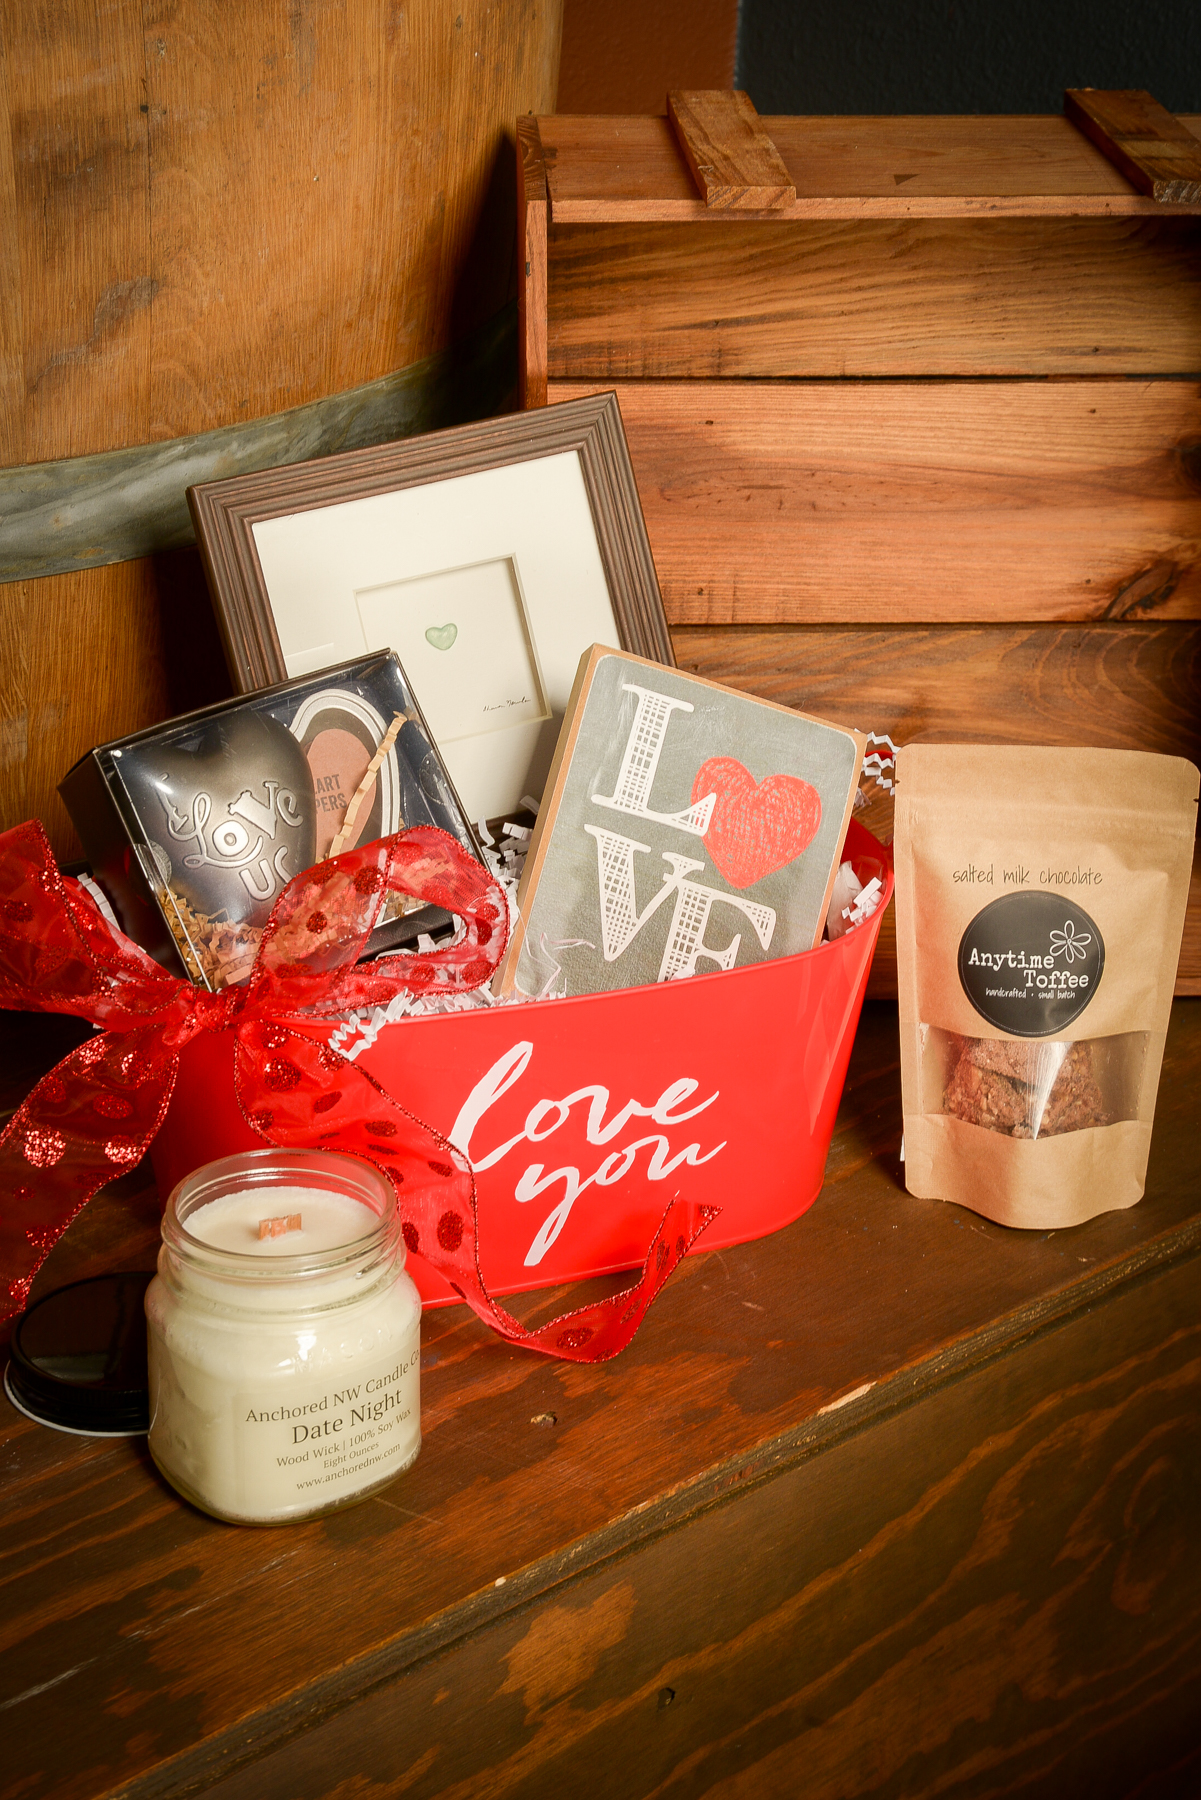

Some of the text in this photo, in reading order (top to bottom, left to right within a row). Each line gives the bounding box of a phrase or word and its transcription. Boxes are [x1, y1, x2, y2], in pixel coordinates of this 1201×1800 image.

[315, 774, 340, 794] ART
[953, 864, 1103, 885] salted milk chocolate
[968, 948, 1054, 971] Anytime
[985, 987, 1075, 999] handcrafted small batch
[1024, 970, 1089, 988] Toffee
[447, 1041, 719, 1173] love
[515, 1135, 727, 1266] you
[245, 1396, 328, 1422] Anchored
[333, 1384, 361, 1406] NW
[365, 1362, 409, 1393] Candle
[292, 1389, 402, 1445] Date Night
[276, 1407, 412, 1467] Wood Wick 100% Soy Wax
[323, 1441, 380, 1469] Eight Ounces
[296, 1443, 401, 1490] www.anchorednw.com
